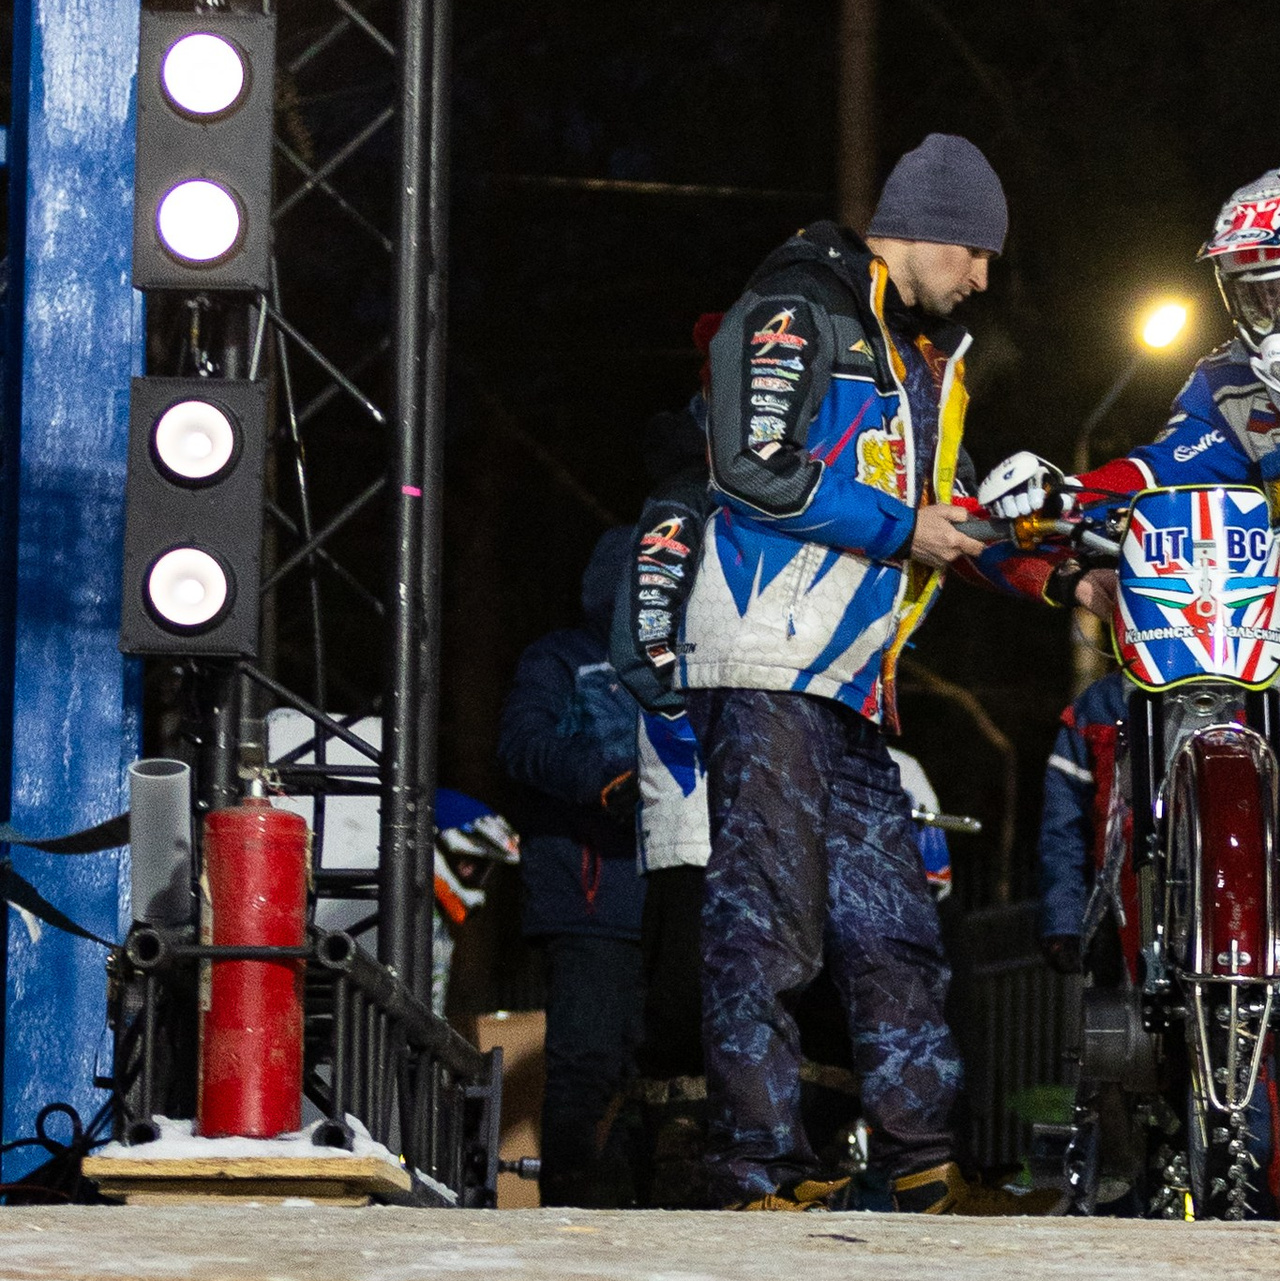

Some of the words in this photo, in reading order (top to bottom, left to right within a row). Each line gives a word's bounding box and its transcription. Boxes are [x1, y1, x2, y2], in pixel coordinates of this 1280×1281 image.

[1144, 529, 1187, 566] ЦТ
[1227, 529, 1267, 561] ВС
[1125, 625, 1195, 645] Каменск
